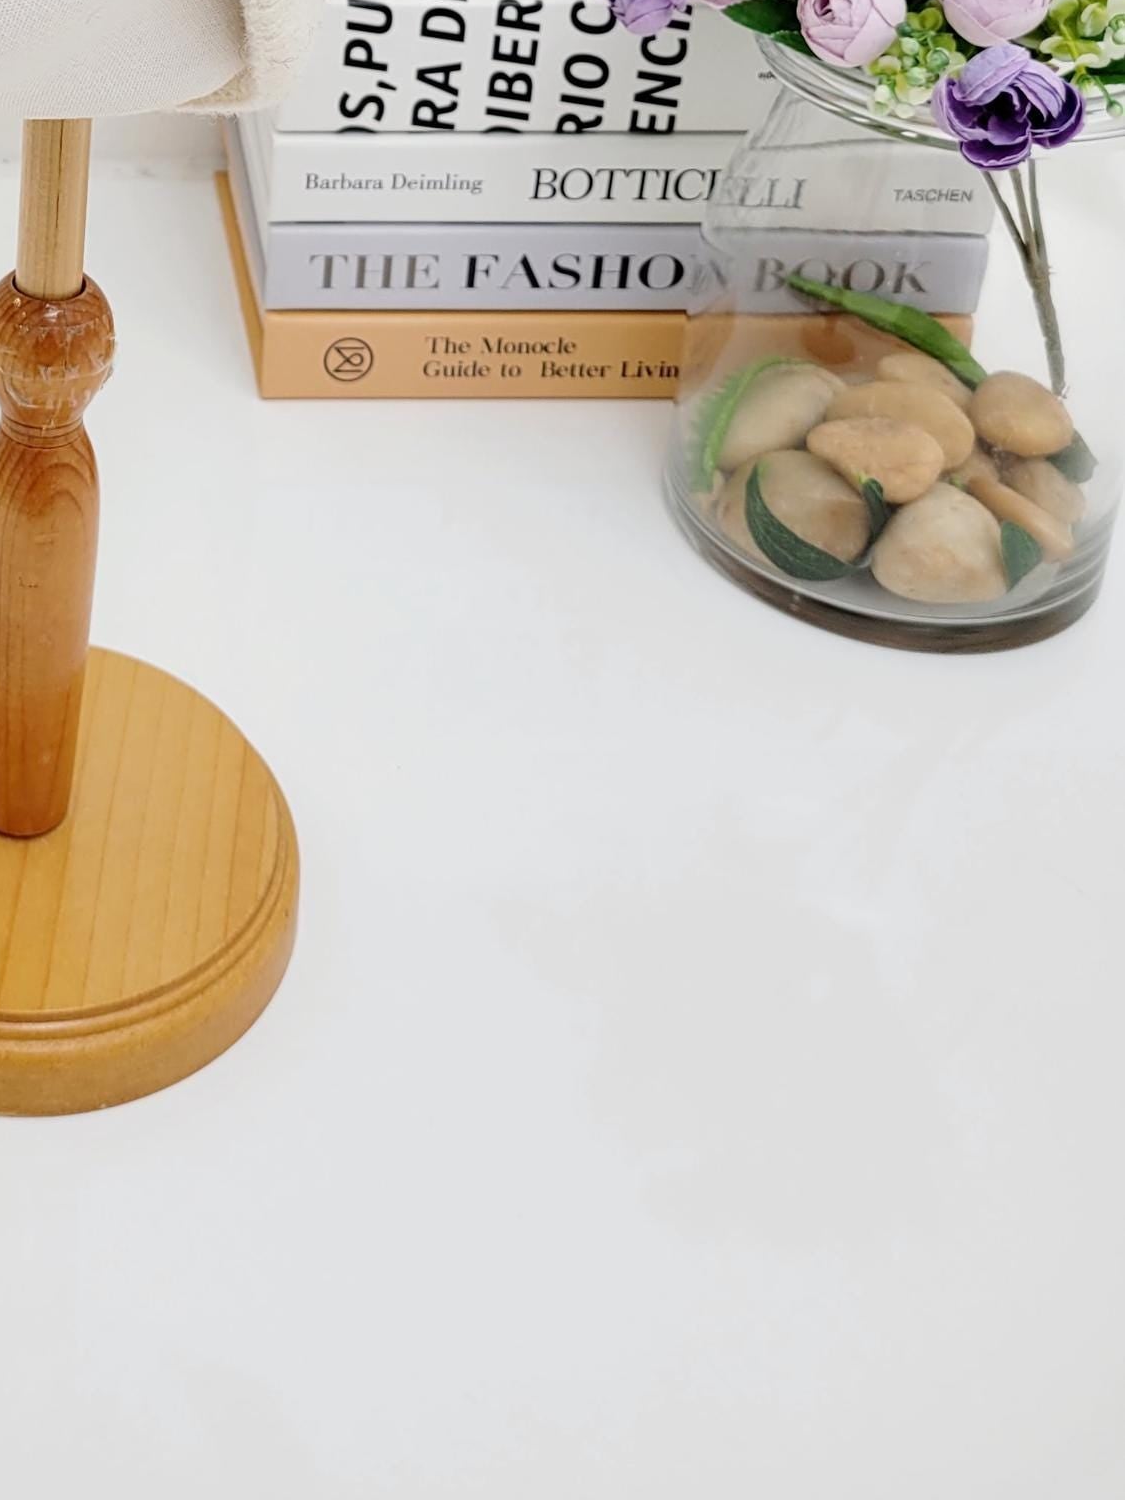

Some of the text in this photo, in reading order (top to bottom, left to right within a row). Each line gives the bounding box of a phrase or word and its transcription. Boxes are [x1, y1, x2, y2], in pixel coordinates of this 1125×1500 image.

[628, 5, 693, 134] ENCI
[304, 173, 483, 194] Barbara Deimling
[893, 188, 973, 204] TASCHEN
[309, 253, 440, 290] THE
[754, 256, 931, 296] BOOK
[425, 336, 577, 354] The Monocle
[422, 359, 679, 378] Guide to Better Livin
